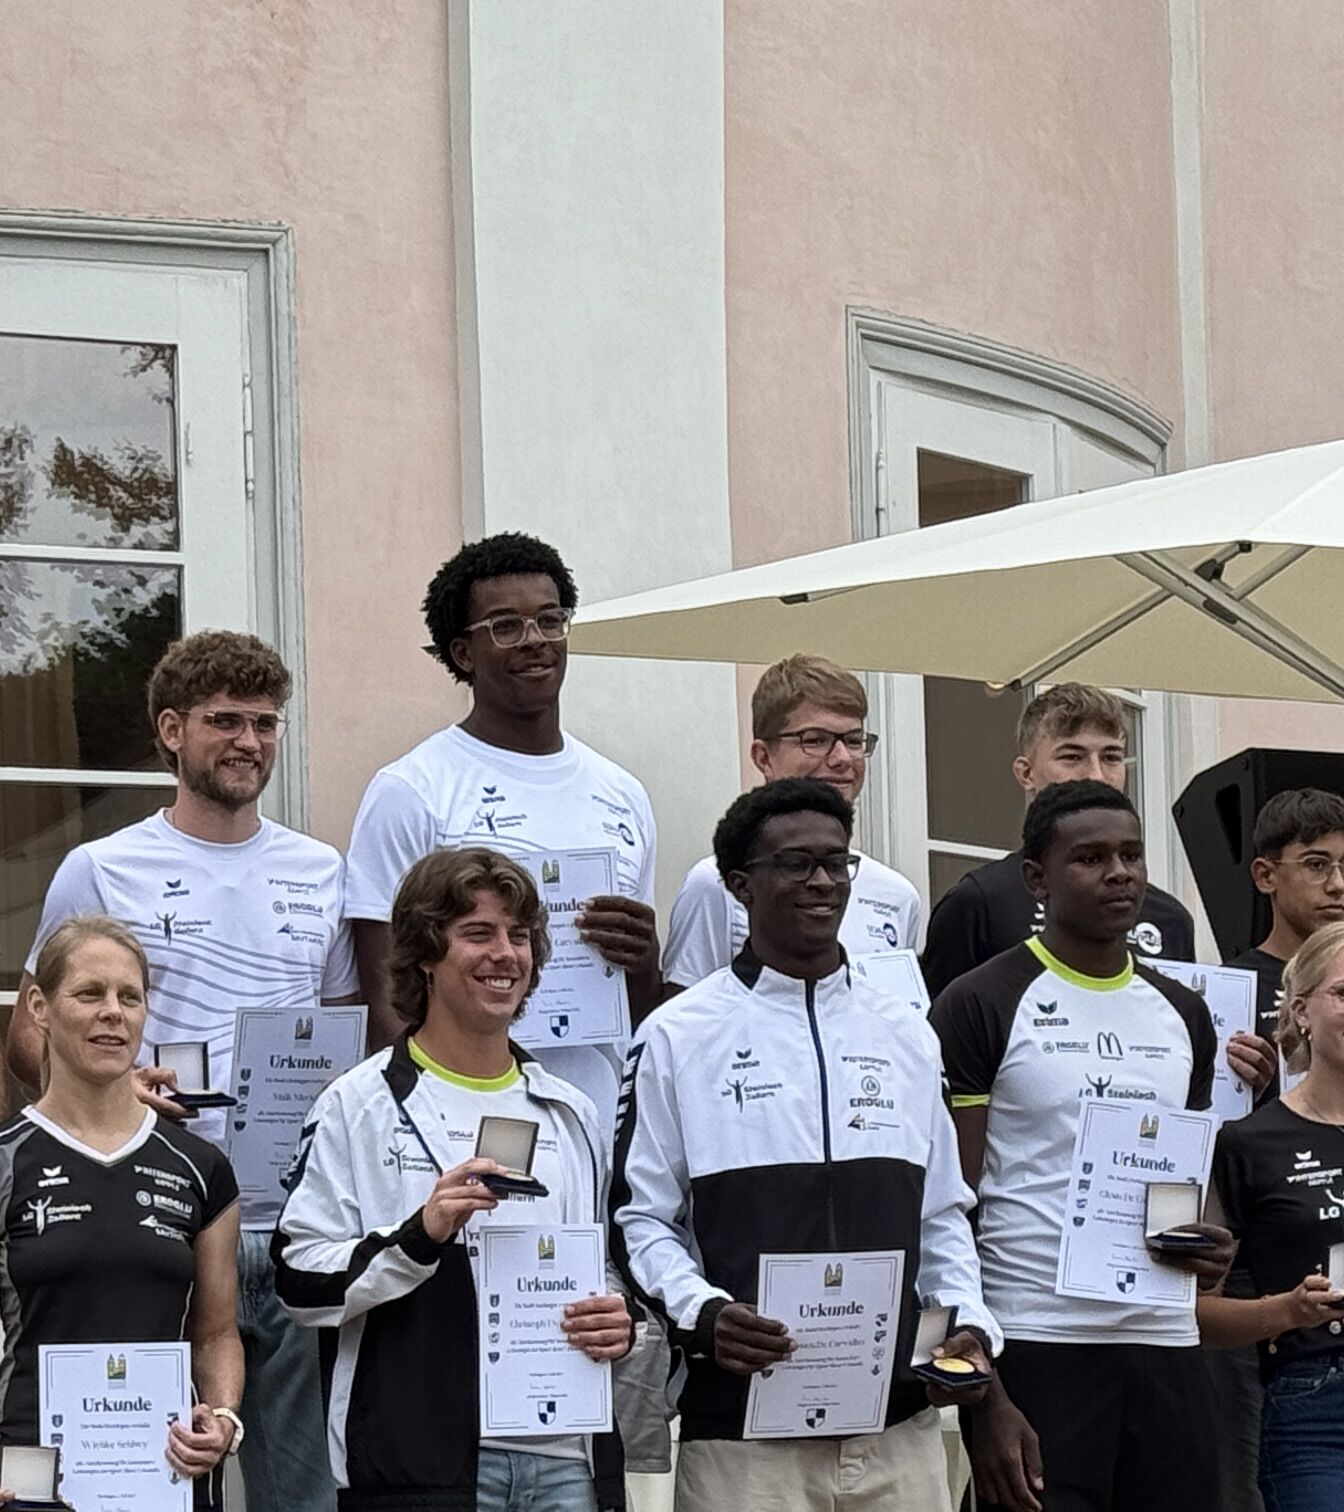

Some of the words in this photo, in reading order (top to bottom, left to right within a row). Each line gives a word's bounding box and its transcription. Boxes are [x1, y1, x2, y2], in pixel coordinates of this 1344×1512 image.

[269, 1054, 333, 1070] Urkunde
[1112, 1150, 1176, 1173] Urkunde
[1319, 1206, 1341, 1220] LG
[516, 1275, 578, 1293] Urkunde
[799, 1301, 864, 1319] Urkunde
[82, 1396, 153, 1413] Urkunde
